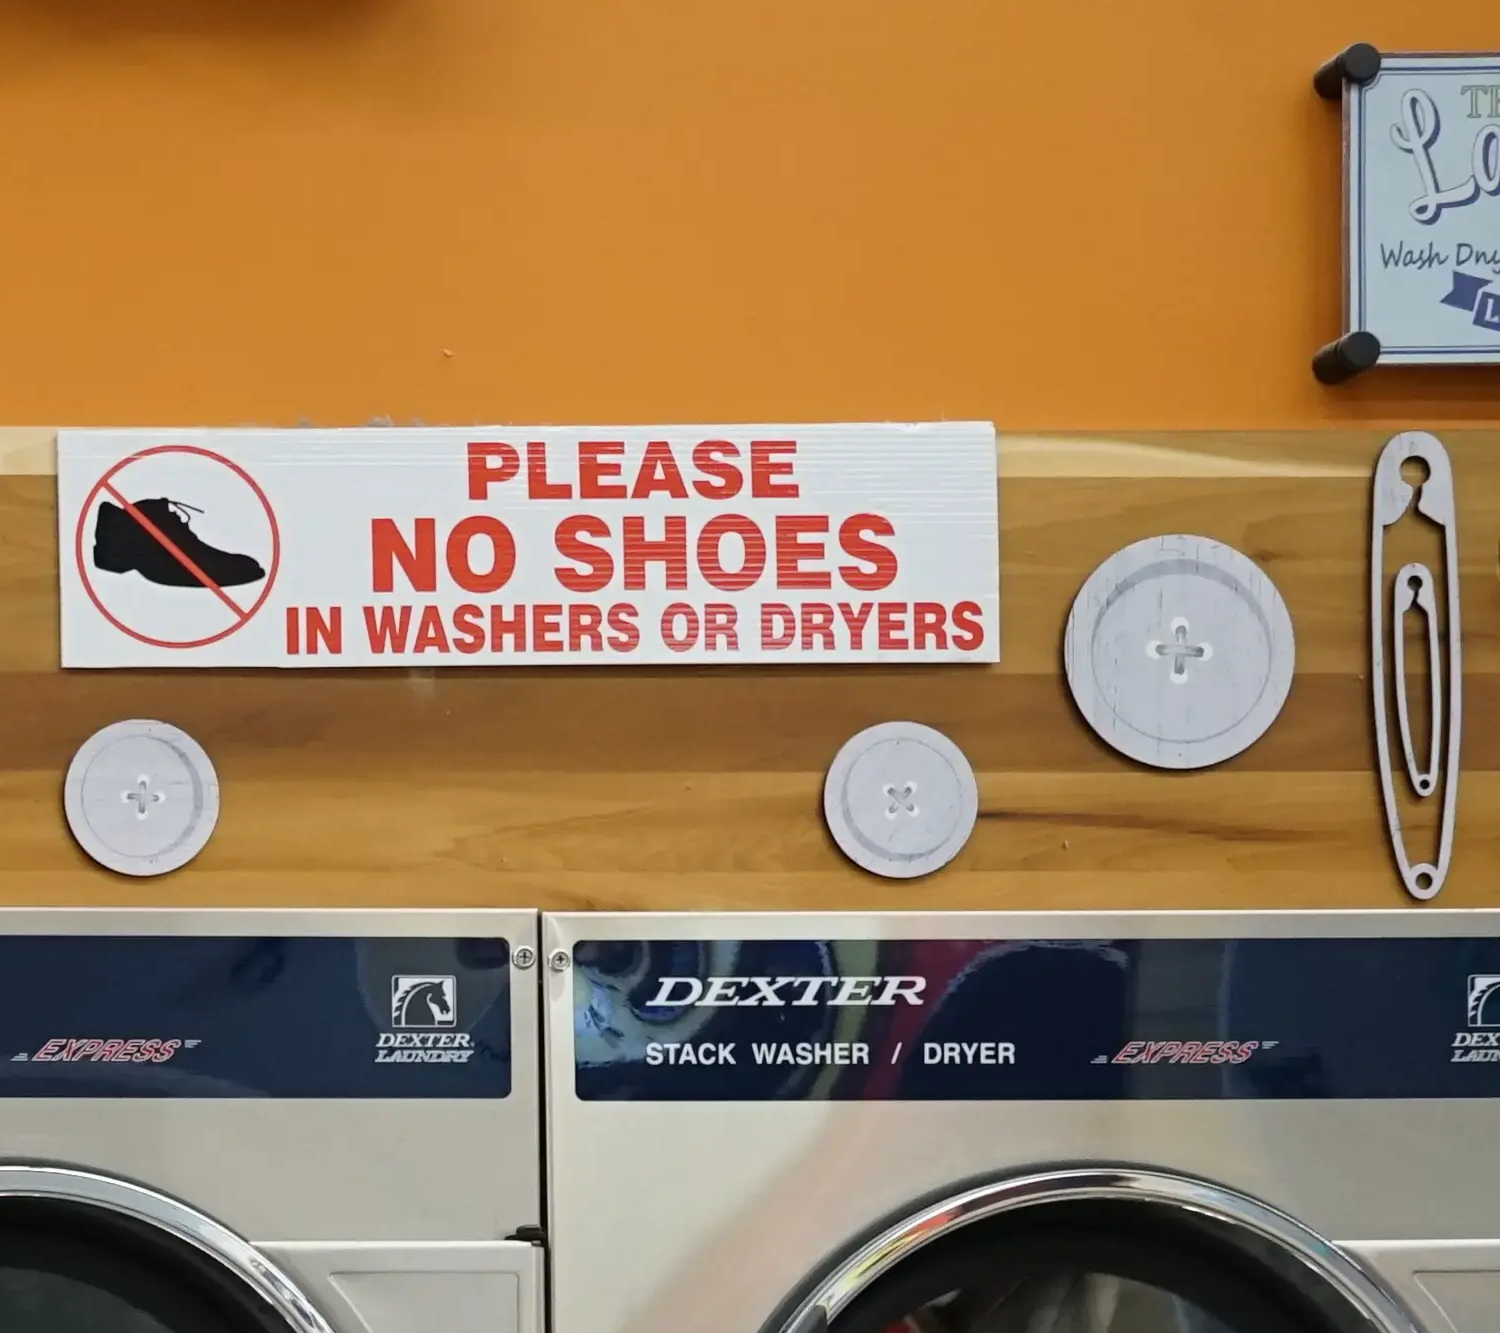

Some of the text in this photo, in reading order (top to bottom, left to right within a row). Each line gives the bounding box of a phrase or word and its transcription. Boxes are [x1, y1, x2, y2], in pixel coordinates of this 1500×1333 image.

[1381, 240, 1449, 269] Wash
[468, 441, 799, 500] PLEASE
[372, 514, 897, 593] NO SHOES
[287, 601, 984, 654] IN WASHERS OR DRYERS
[646, 976, 926, 1006] DEXTER
[31, 1038, 182, 1062] EXPRESS
[376, 1033, 475, 1048] DEXTER
[646, 1042, 736, 1065] STACK
[752, 1043, 869, 1064] WASHER
[924, 1043, 1014, 1064] DRYER
[1111, 1041, 1260, 1065] EXPRESS
[375, 1050, 474, 1064] LAUNDRY
